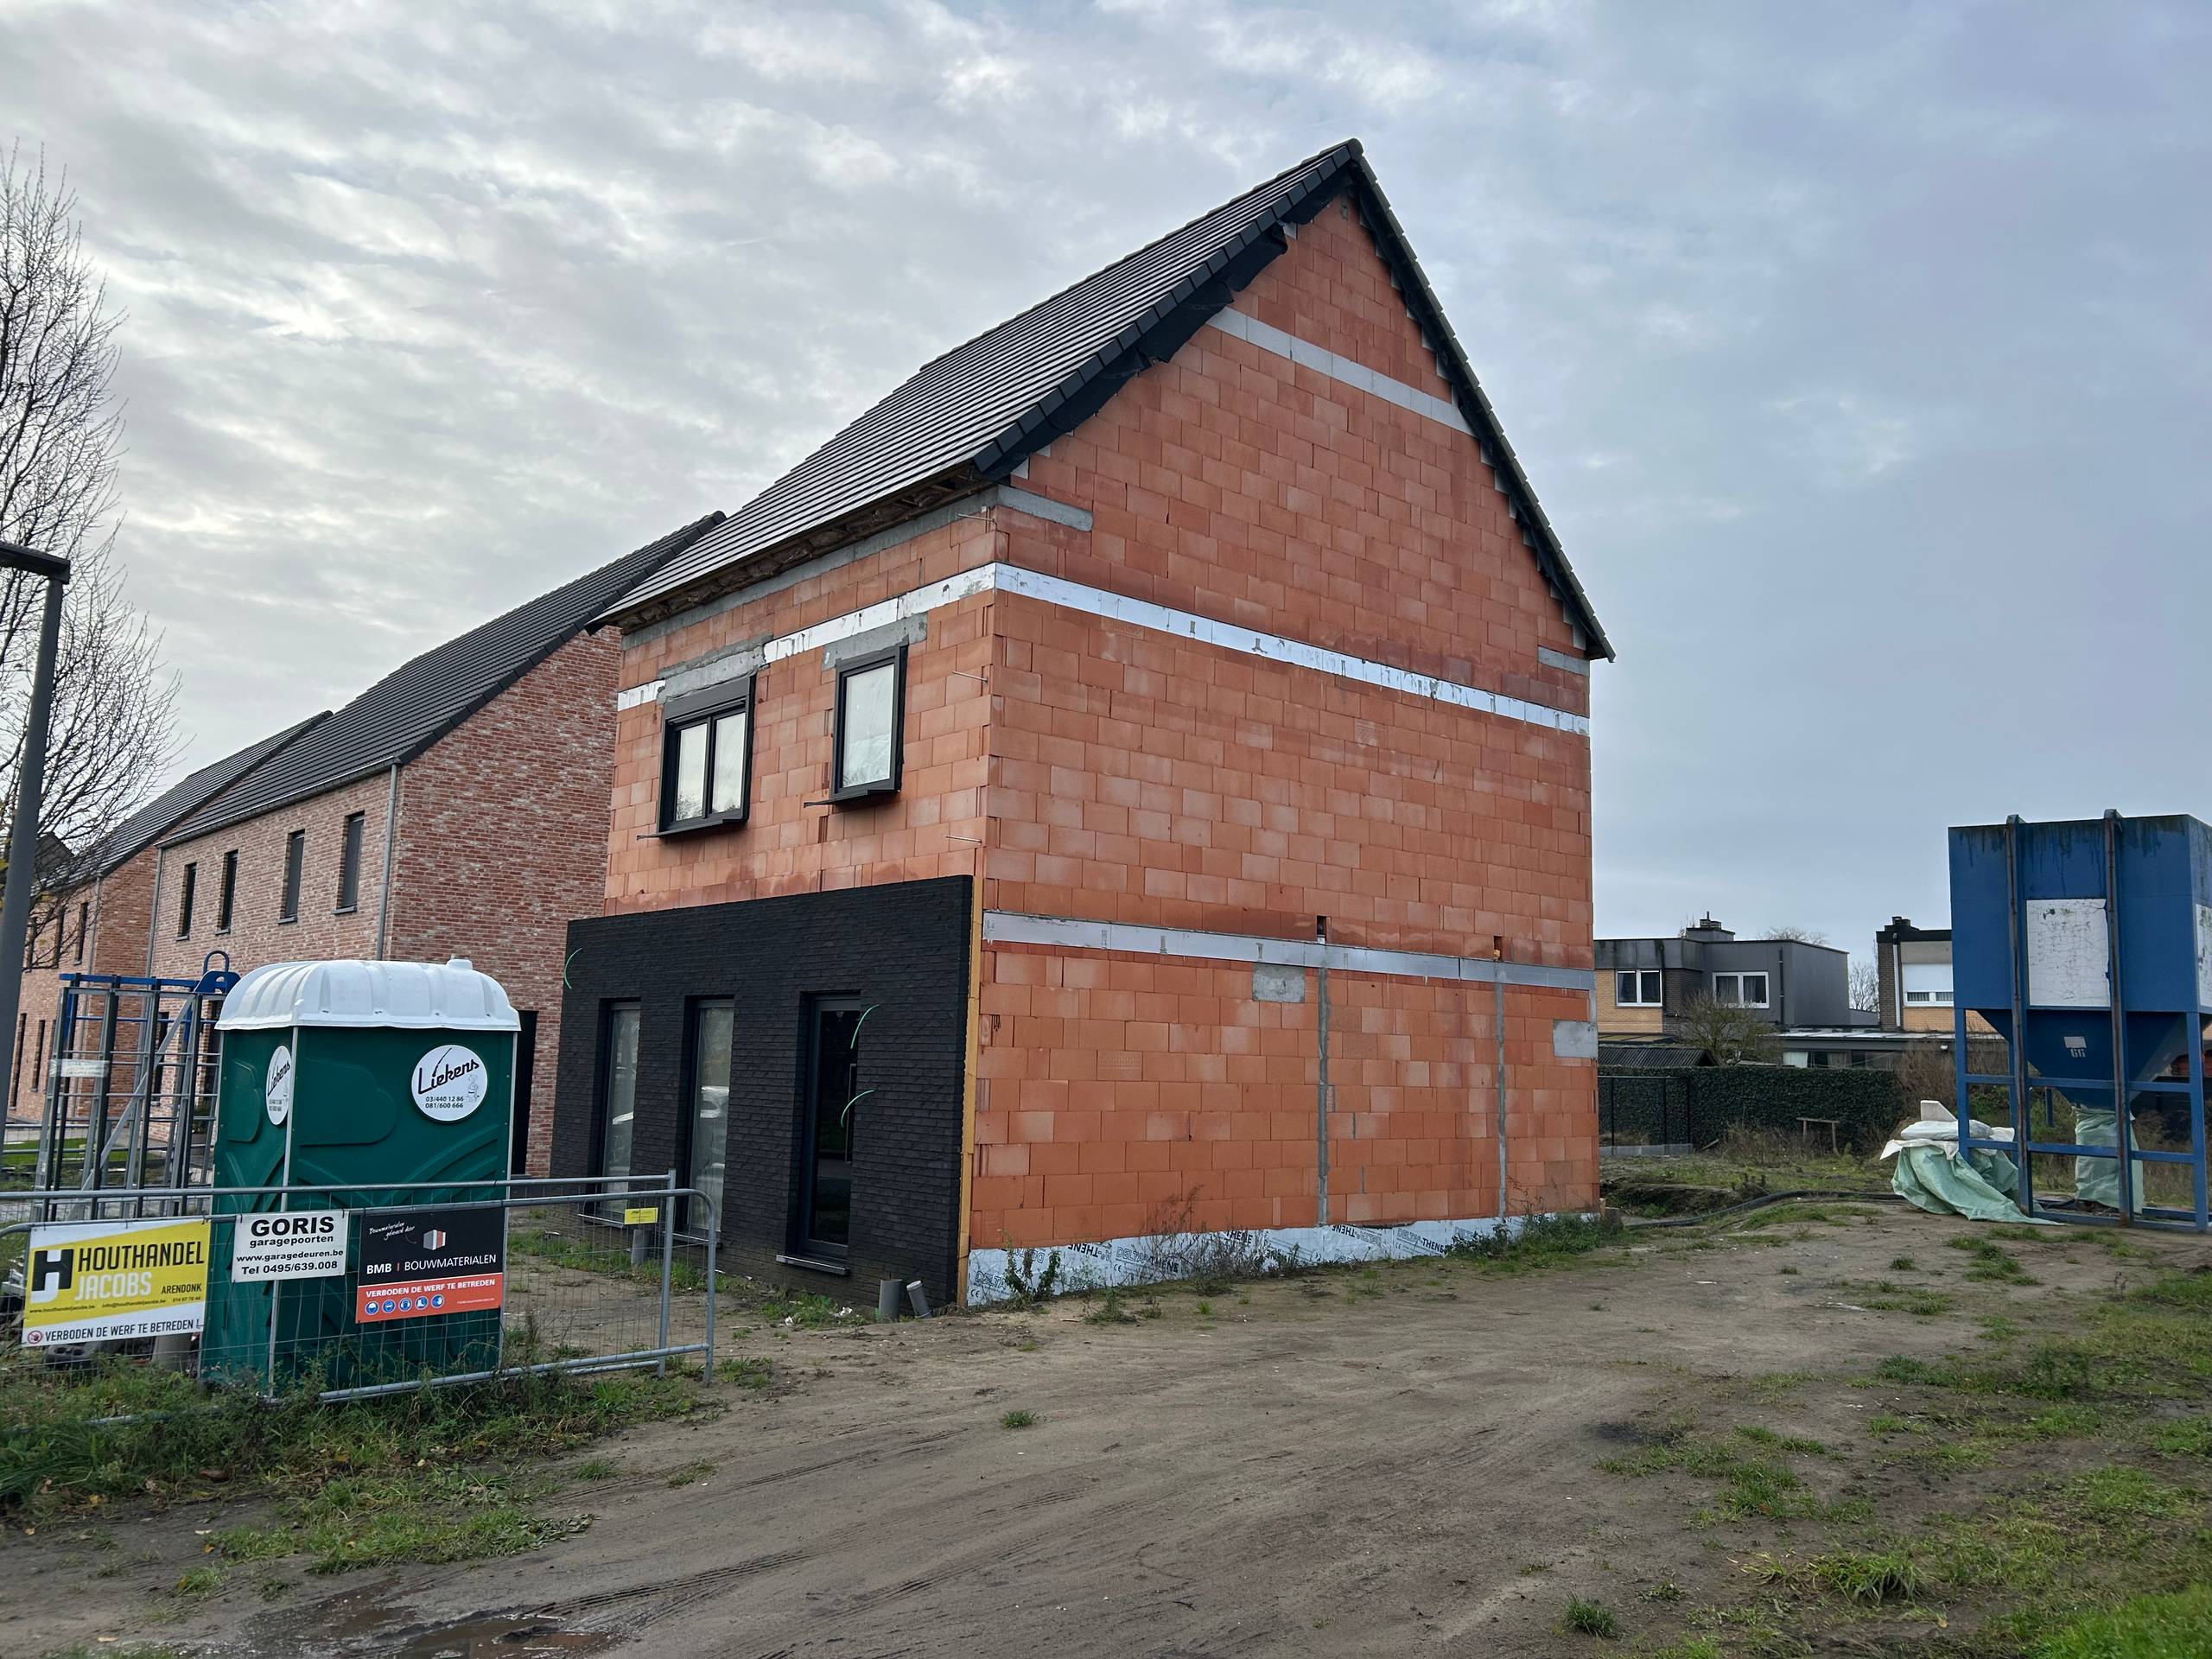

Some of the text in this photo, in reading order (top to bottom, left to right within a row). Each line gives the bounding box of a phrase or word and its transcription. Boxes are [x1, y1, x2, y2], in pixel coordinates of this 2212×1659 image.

[418, 1047, 480, 1095] Liekens
[251, 1216, 334, 1236] GORIS
[250, 1236, 334, 1248] garagepoorten
[78, 1241, 205, 1272] HOUTHANDEL
[237, 1249, 344, 1262] www.garagedeuren.be
[366, 1254, 497, 1274] BMB BOUWMATERIALEN
[242, 1261, 338, 1274] Tel 0495/639.008
[74, 1271, 152, 1300] JACOBS
[161, 1283, 202, 1294] ARENDONK
[366, 1287, 409, 1298] VERBODEN
[423, 1282, 446, 1292] WERF
[457, 1278, 495, 1288] BETREDEN
[46, 1328, 93, 1341] VERBODEN
[96, 1326, 108, 1337] DE
[110, 1325, 136, 1336] WERF
[138, 1323, 149, 1333] TE
[150, 1319, 194, 1332] BETREDEN
